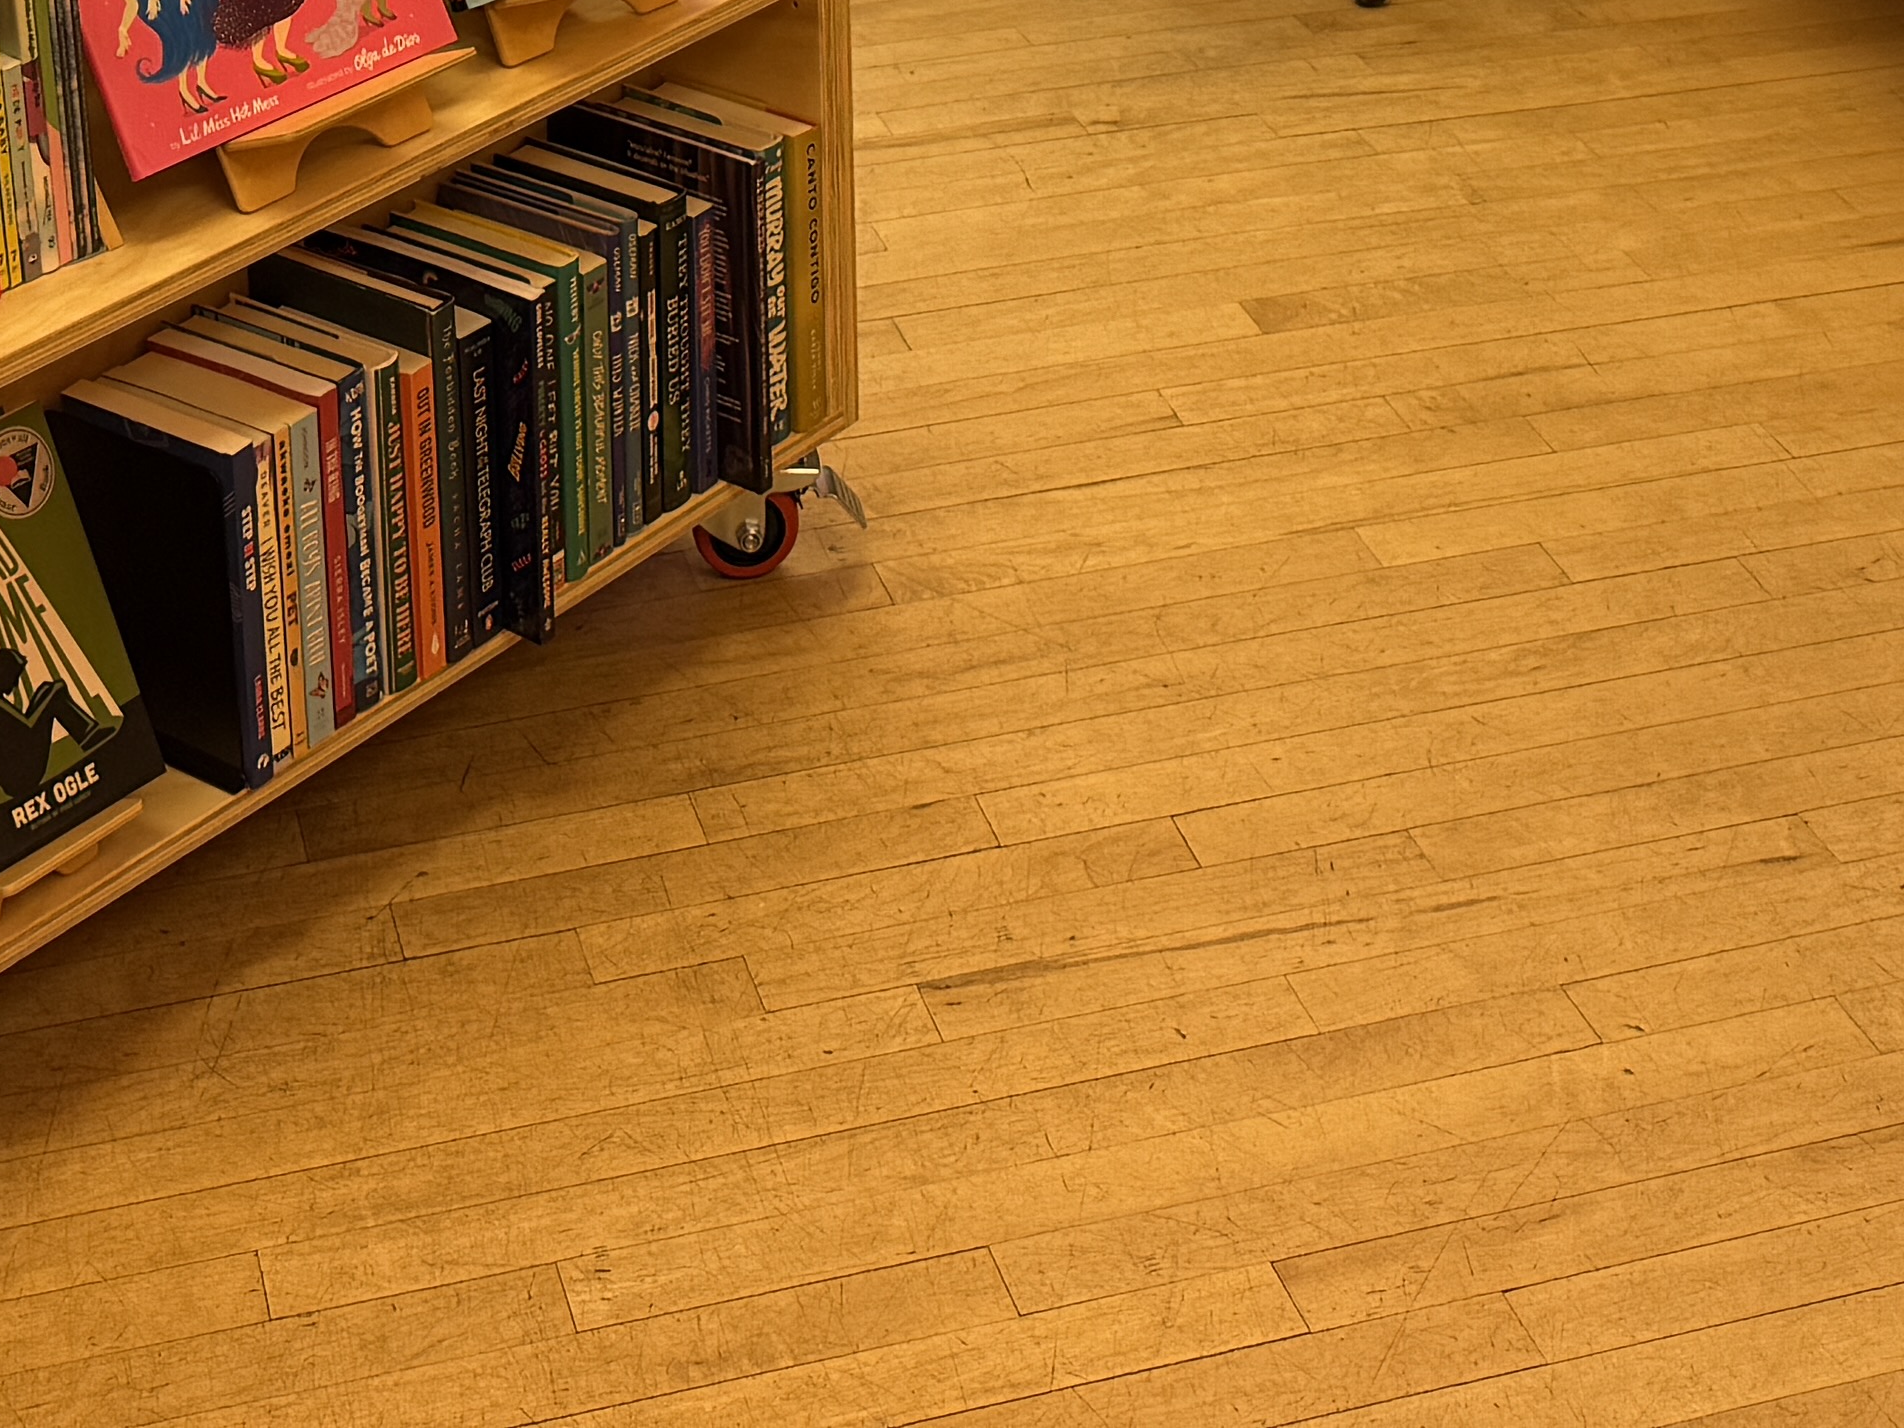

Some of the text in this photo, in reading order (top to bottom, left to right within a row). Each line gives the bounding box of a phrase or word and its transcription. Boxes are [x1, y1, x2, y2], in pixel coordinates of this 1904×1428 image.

[807, 143, 821, 305] CANTO CONTIGO
[11, 762, 100, 829] REX OGLE
